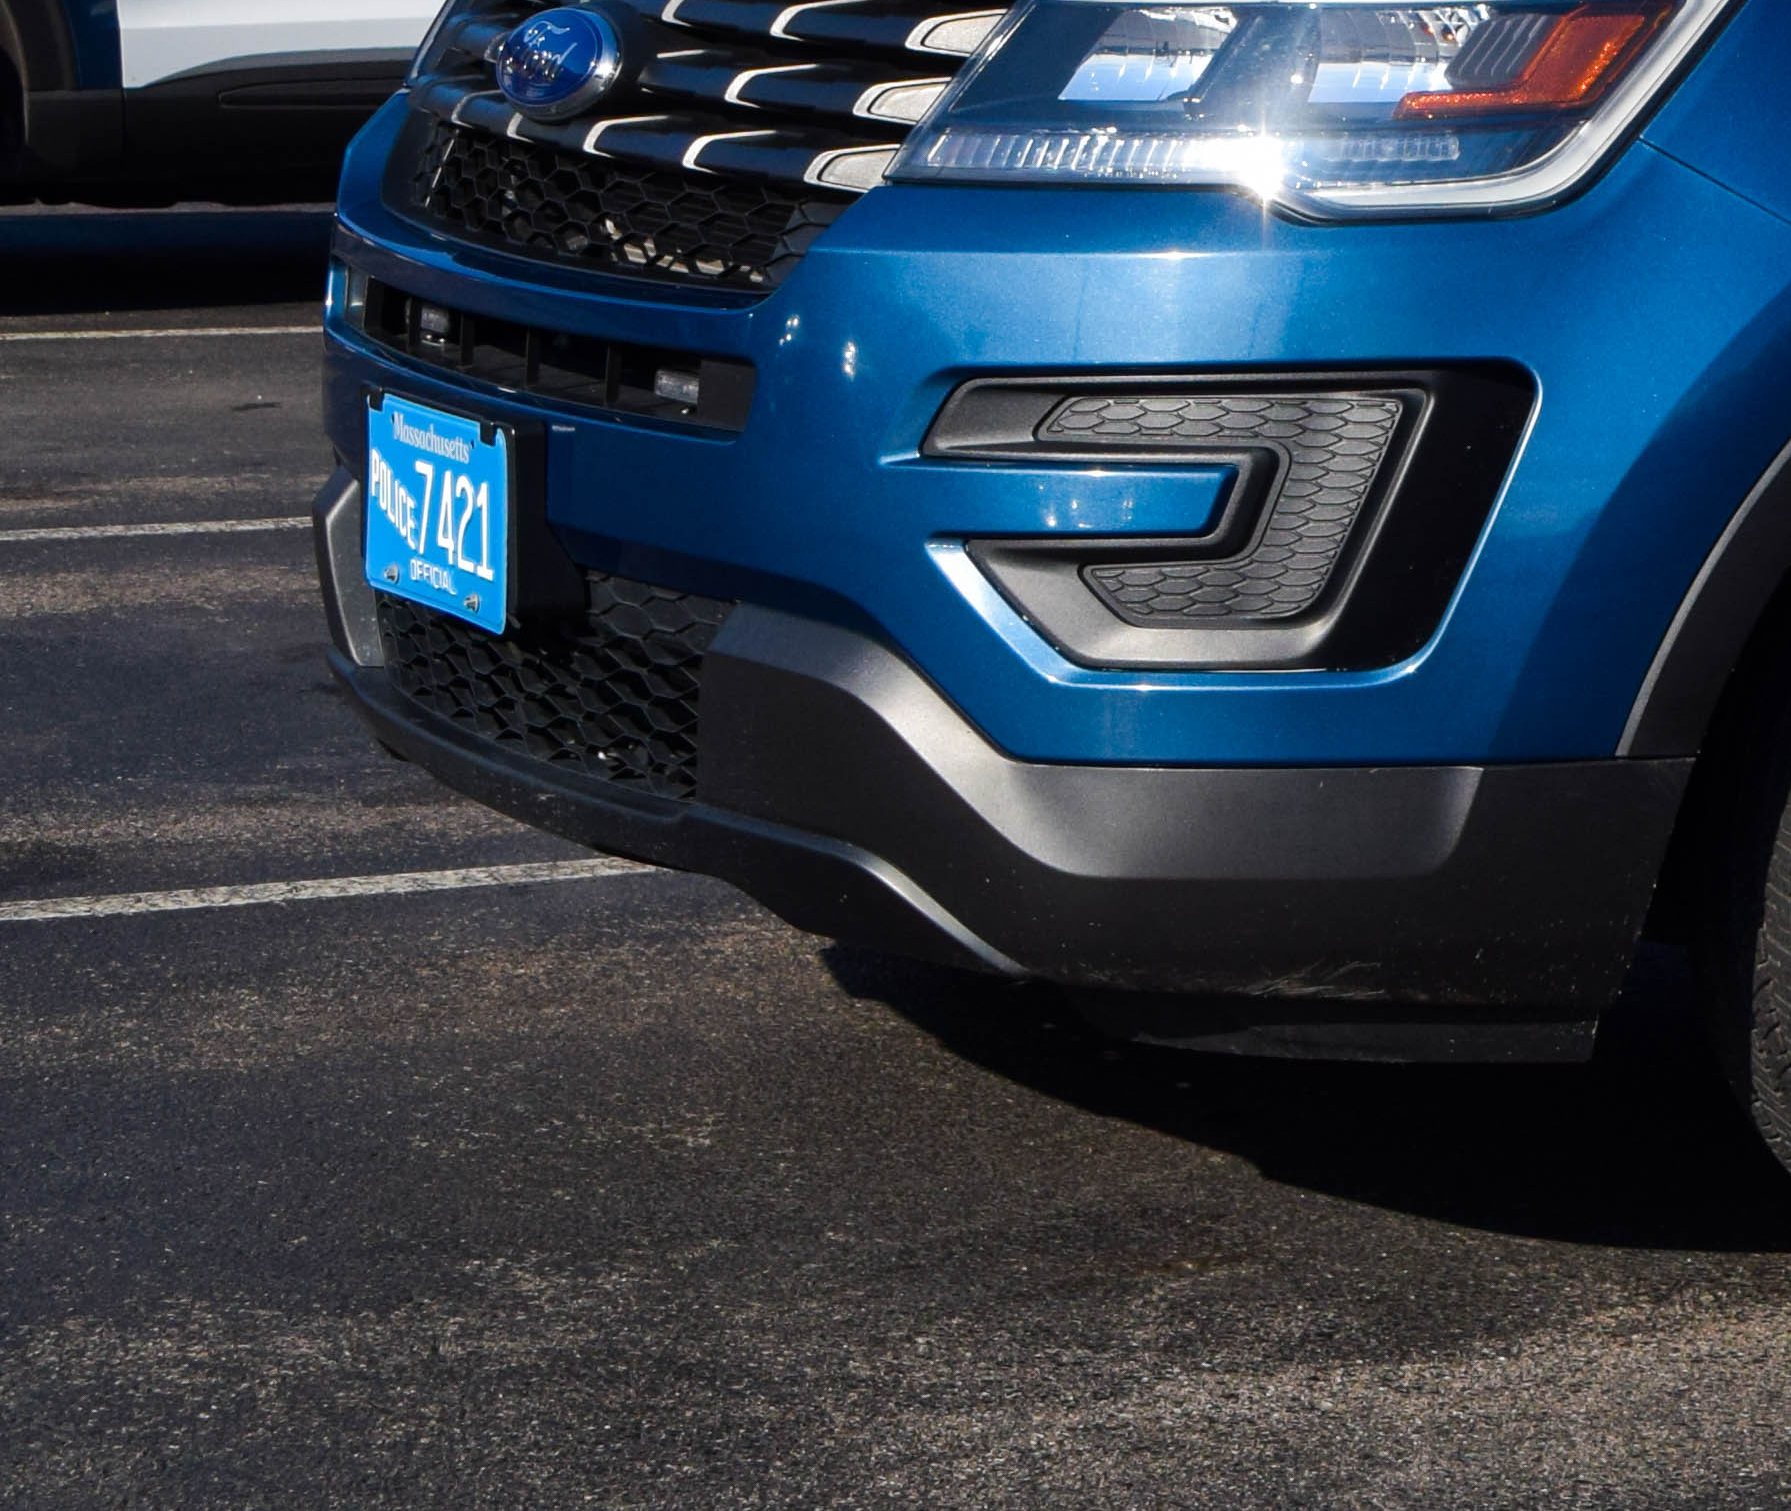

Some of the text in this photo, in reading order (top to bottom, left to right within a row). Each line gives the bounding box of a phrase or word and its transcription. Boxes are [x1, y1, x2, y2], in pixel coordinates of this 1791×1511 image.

[508, 20, 578, 81] Ford
[392, 411, 470, 465] Massachusetts
[370, 448, 495, 582] POLICE 7421
[409, 558, 457, 596] OFFICIAL
